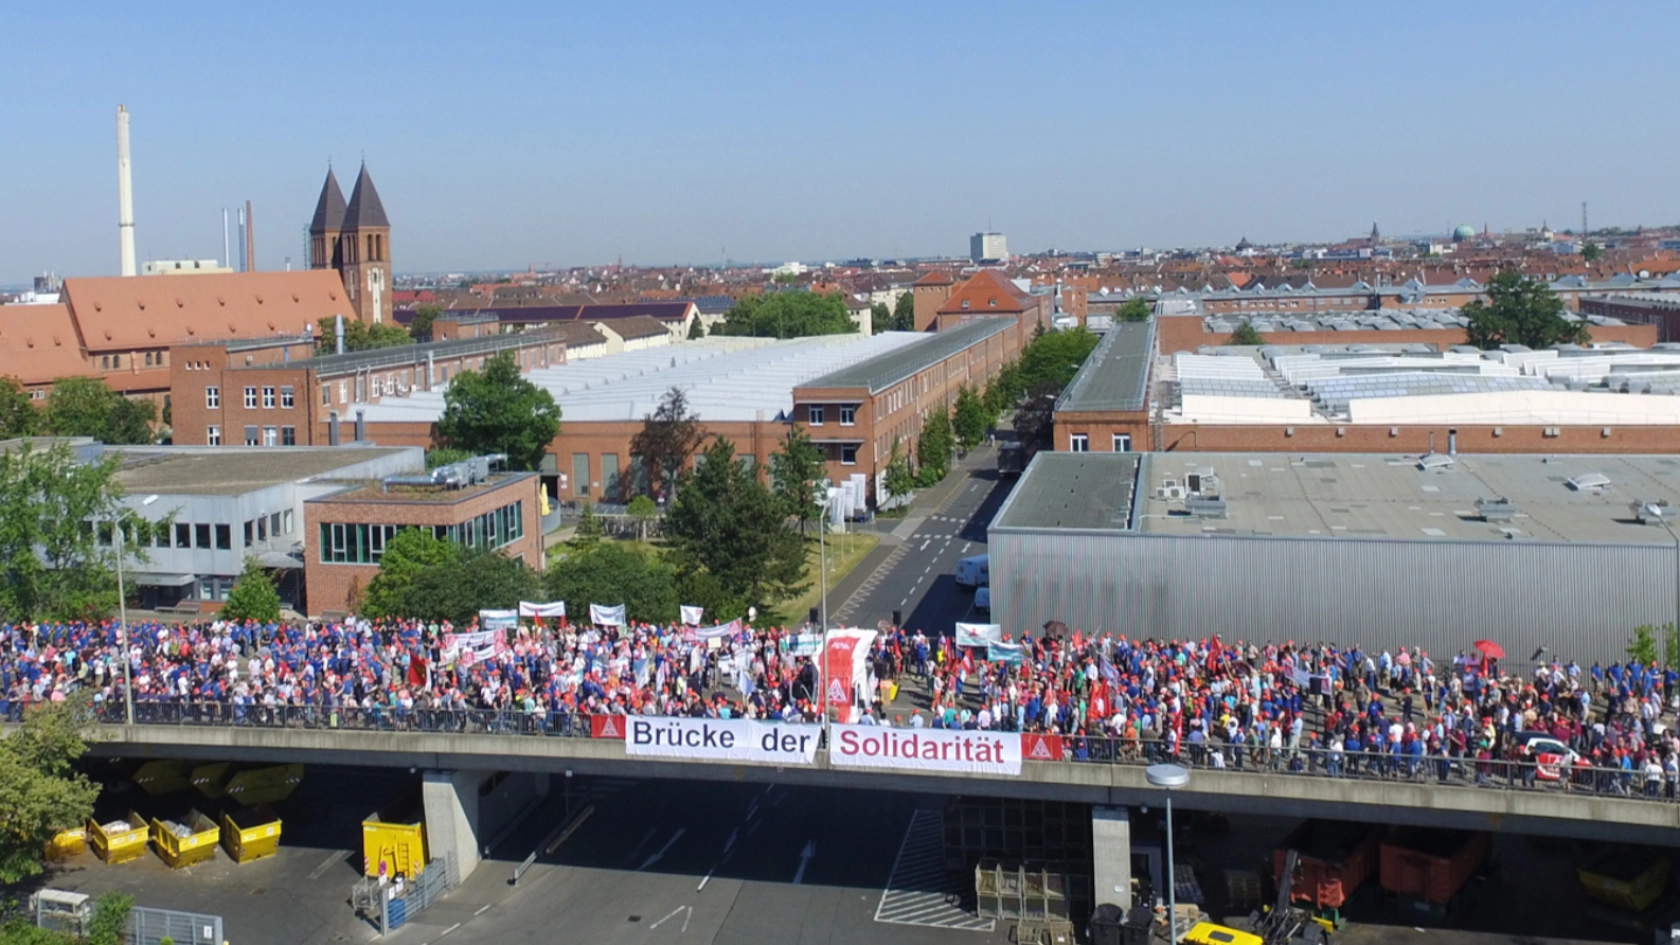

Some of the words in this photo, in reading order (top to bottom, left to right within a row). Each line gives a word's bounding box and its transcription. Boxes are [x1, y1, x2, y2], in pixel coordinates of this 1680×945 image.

[634, 720, 736, 749] Brücke
[761, 722, 811, 752] der
[840, 730, 1004, 763] Solidarität
